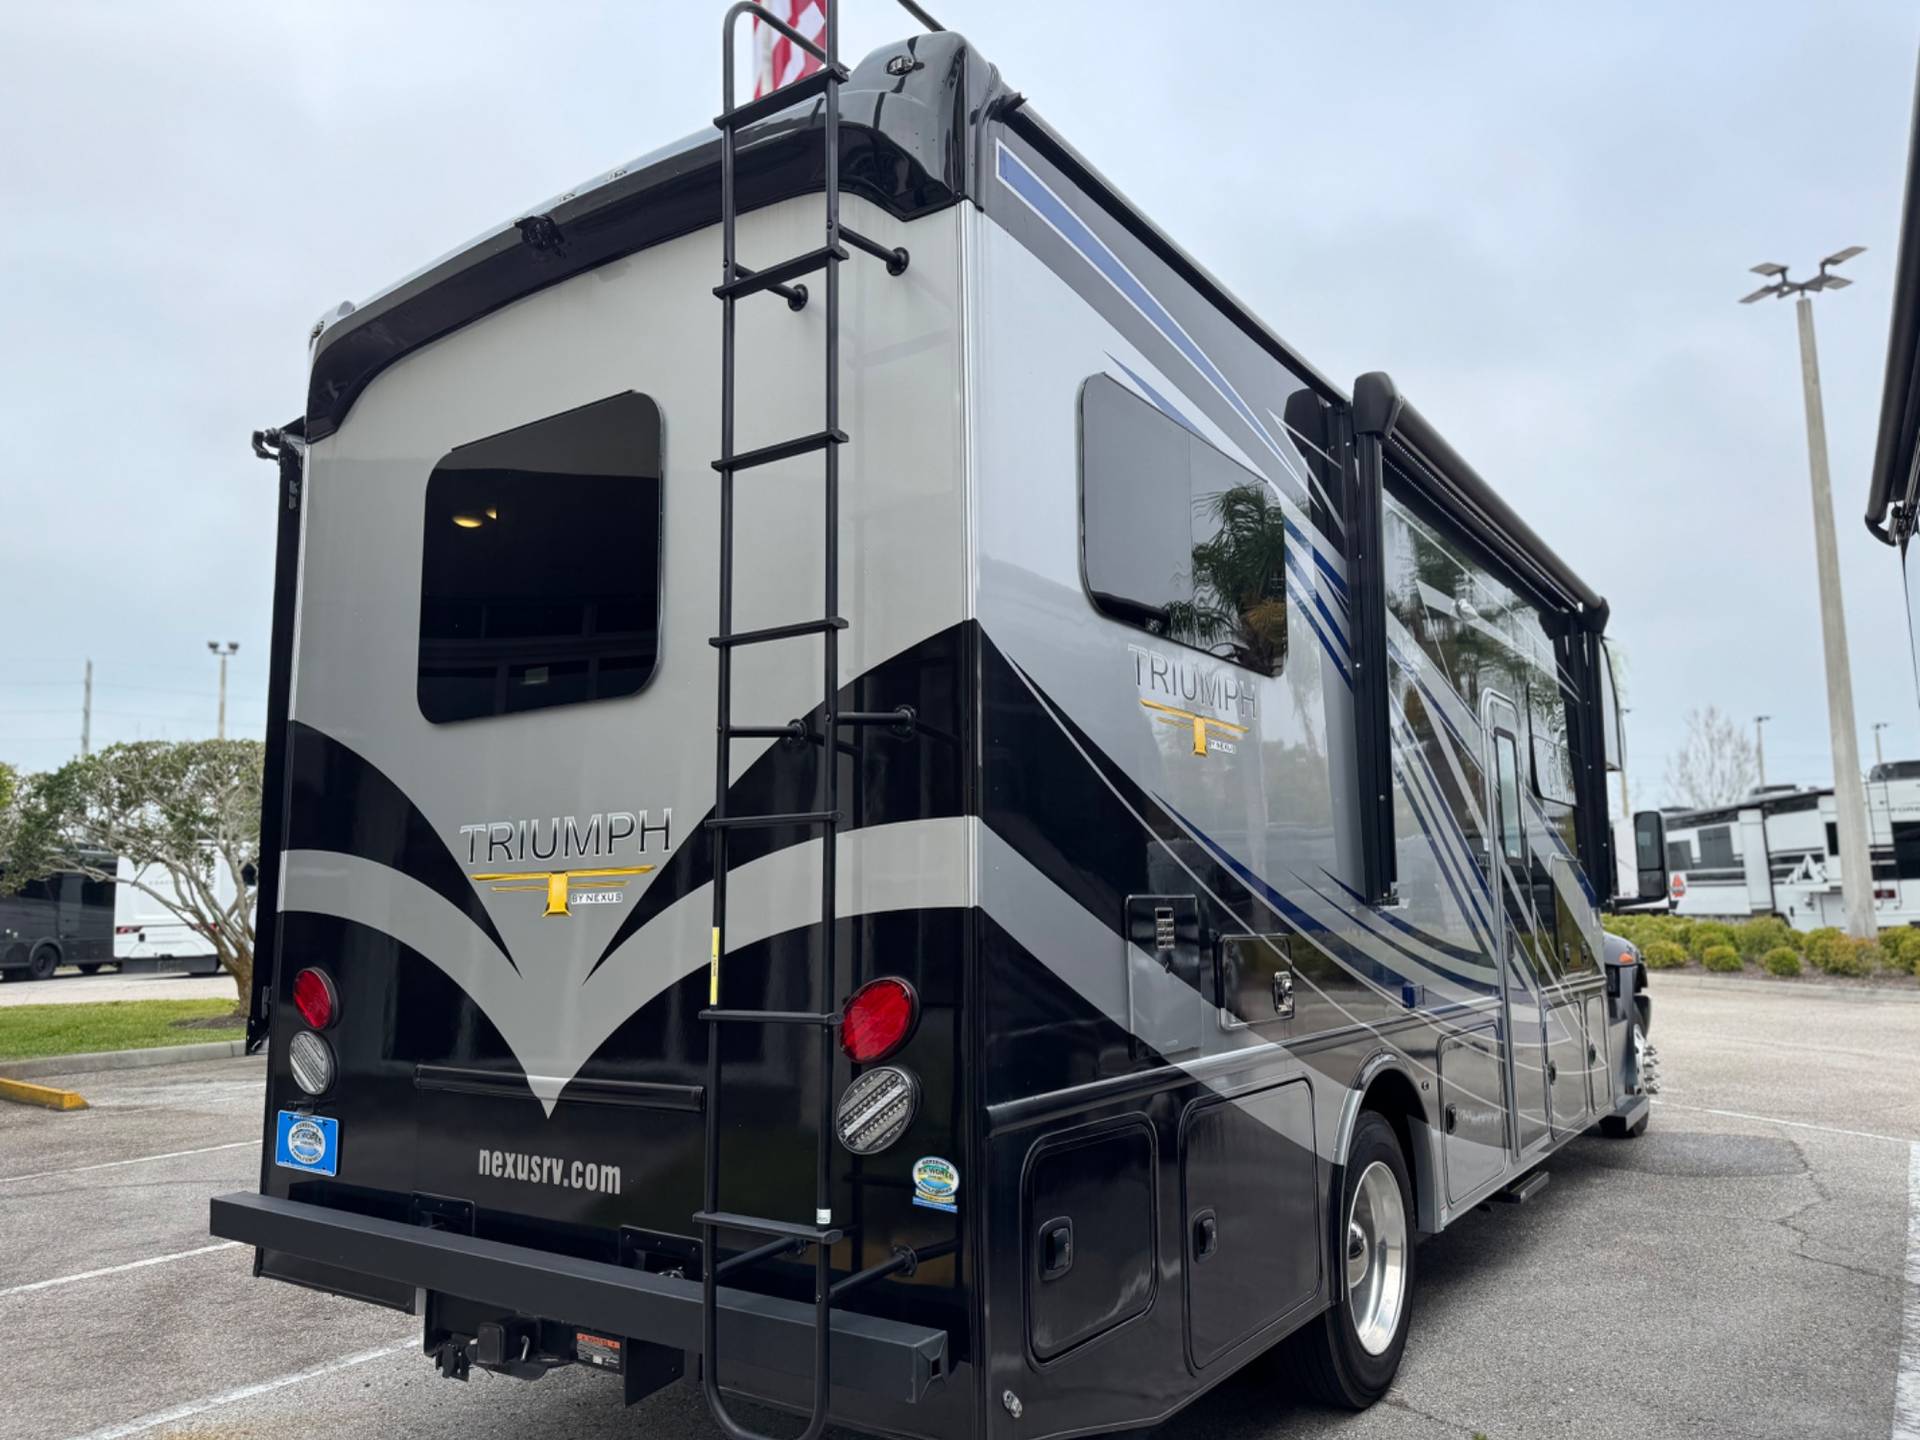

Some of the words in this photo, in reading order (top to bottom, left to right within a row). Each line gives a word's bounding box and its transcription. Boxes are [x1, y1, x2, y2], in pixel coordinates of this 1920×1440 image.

[1128, 644, 1256, 720] TRIUMPH
[459, 808, 672, 864] TRIUMPH
[571, 894, 584, 904] BY
[585, 891, 623, 904] NEXUS
[478, 1149, 621, 1195] nexusrv.com
